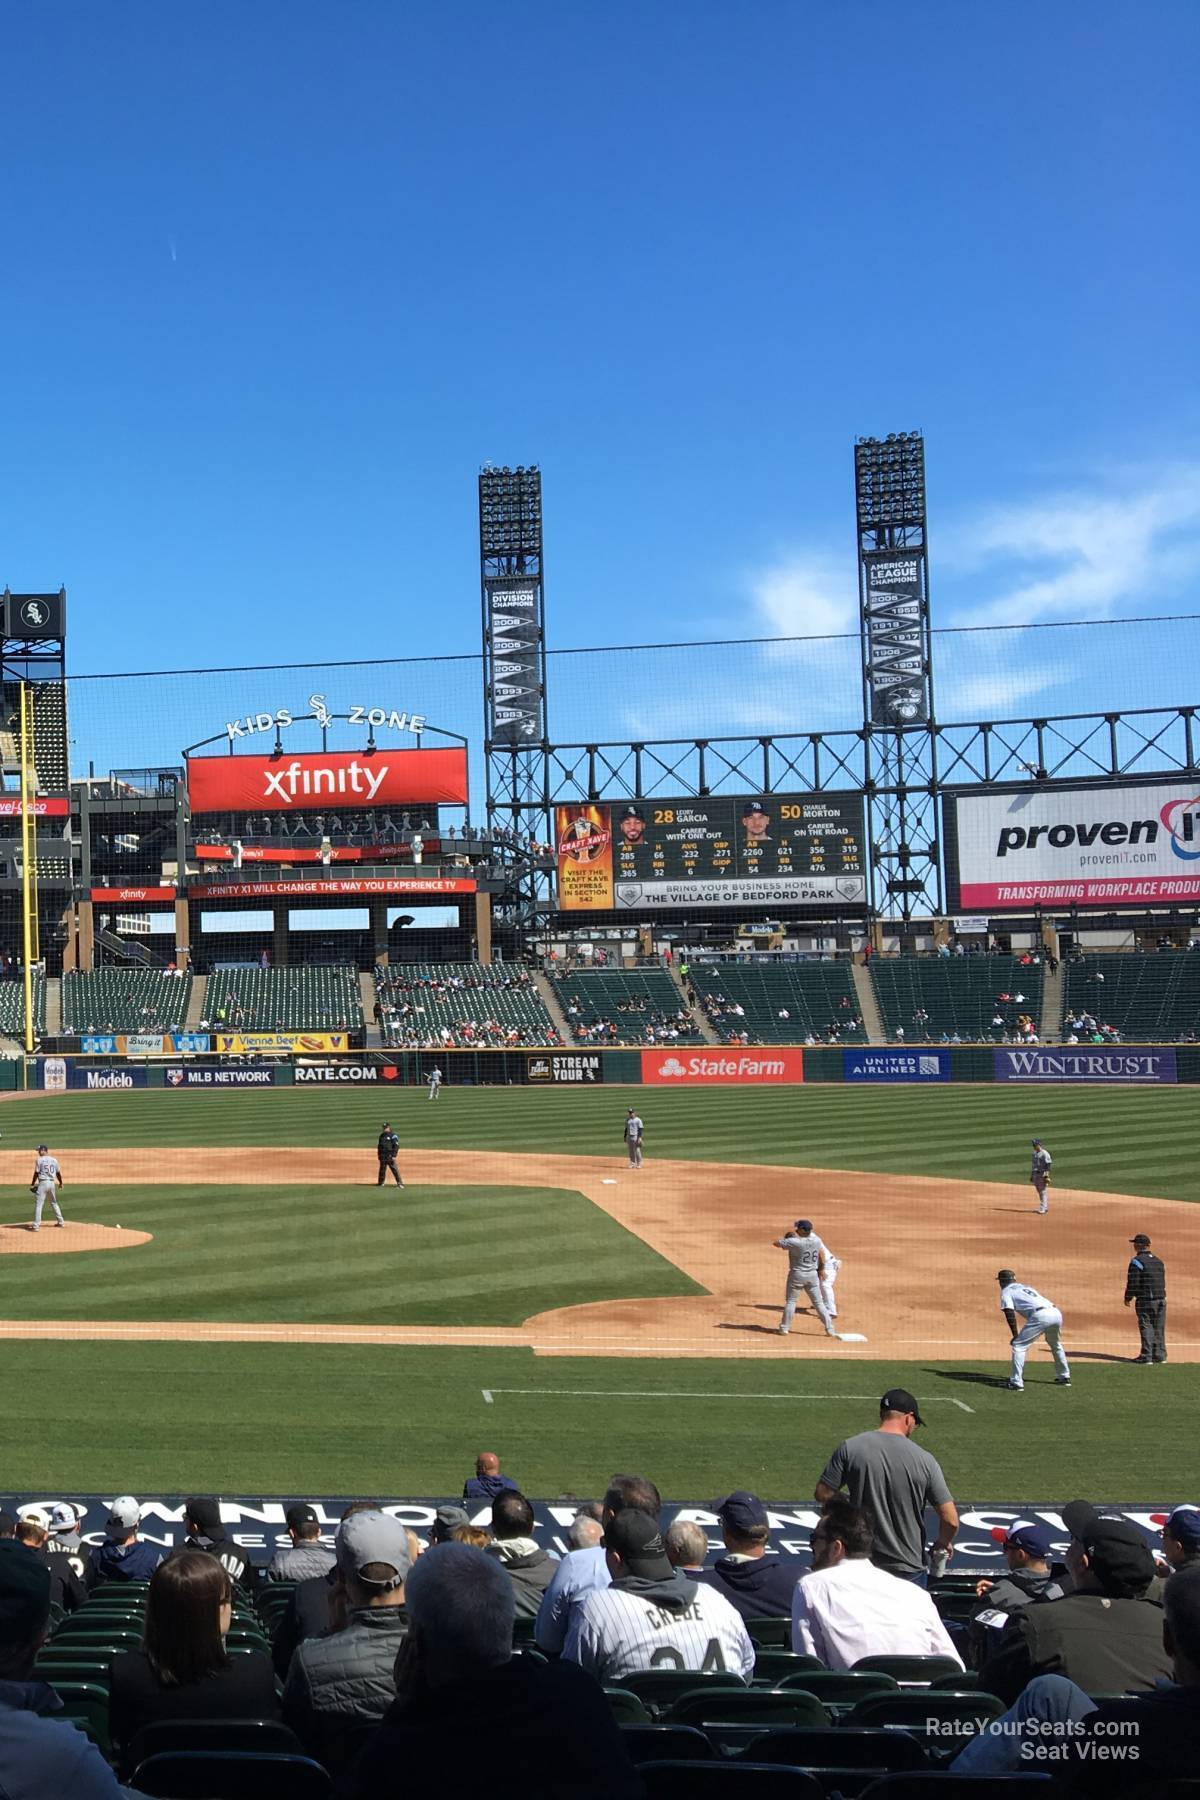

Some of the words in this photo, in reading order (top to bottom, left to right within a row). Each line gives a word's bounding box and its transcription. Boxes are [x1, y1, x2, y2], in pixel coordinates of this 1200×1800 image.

[870, 561, 917, 571] AMERICAN
[870, 568, 917, 580] LEAGUE
[870, 577, 917, 586] CHAMPIONS
[492, 594, 534, 603] DIVISION
[225, 708, 293, 740] KIDS
[349, 705, 426, 735] ZONE
[264, 761, 388, 803] xfinity
[654, 810, 674, 824] 28
[781, 805, 801, 819] 50
[803, 810, 841, 818] MORTON
[676, 814, 708, 823] GARCIA
[1182, 812, 1200, 842] I
[996, 819, 1159, 857] proven
[561, 840, 585, 851] CRAFT
[620, 852, 635, 860] 285
[1080, 853, 1157, 868] provenIT.com
[620, 870, 637, 878] .365
[654, 869, 665, 877] 32
[687, 868, 694, 876] 6
[719, 867, 725, 875] 7
[748, 866, 759, 874] 54
[777, 865, 793, 873] 234
[841, 863, 860, 871] .415
[207, 886, 238, 896] XFINITY
[241, 885, 251, 894] X1
[253, 884, 275, 893] WILL
[277, 882, 317, 892] CHANGE
[319, 882, 338, 891] THE
[340, 881, 362, 891] WAY
[364, 881, 385, 890] YOU
[387, 880, 442, 890] EXPERIENCE
[445, 881, 456, 889] TV
[666, 885, 697, 893] BRING
[701, 883, 729, 892] YOUR
[732, 882, 781, 891] BUSINESS
[785, 881, 815, 889] HOME
[997, 885, 1085, 900] TRANSFORMING
[1087, 882, 1157, 897] WORKPLACE
[120, 890, 146, 900] xfinity
[645, 894, 668, 903] THE
[670, 893, 716, 902] VILLAGE
[722, 893, 739, 901] OF
[742, 891, 798, 900] BEDFORD
[801, 890, 834, 899] PARK
[129, 1035, 152, 1048] Bring
[153, 1036, 161, 1047] it
[240, 1036, 274, 1046] Vienna
[276, 1035, 298, 1045] Beef
[553, 1057, 599, 1069] STREAM
[865, 1057, 916, 1066] UNITED
[1008, 1053, 1161, 1074] WINTRUST
[295, 1067, 377, 1081] RATE.COM
[553, 1069, 583, 1080] YOUR
[853, 1065, 916, 1074] AIRLINES
[87, 1071, 133, 1089] Modelo
[188, 1072, 211, 1082] MLB
[215, 1071, 271, 1082] NETWORK
[44, 1165, 55, 1174] 50
